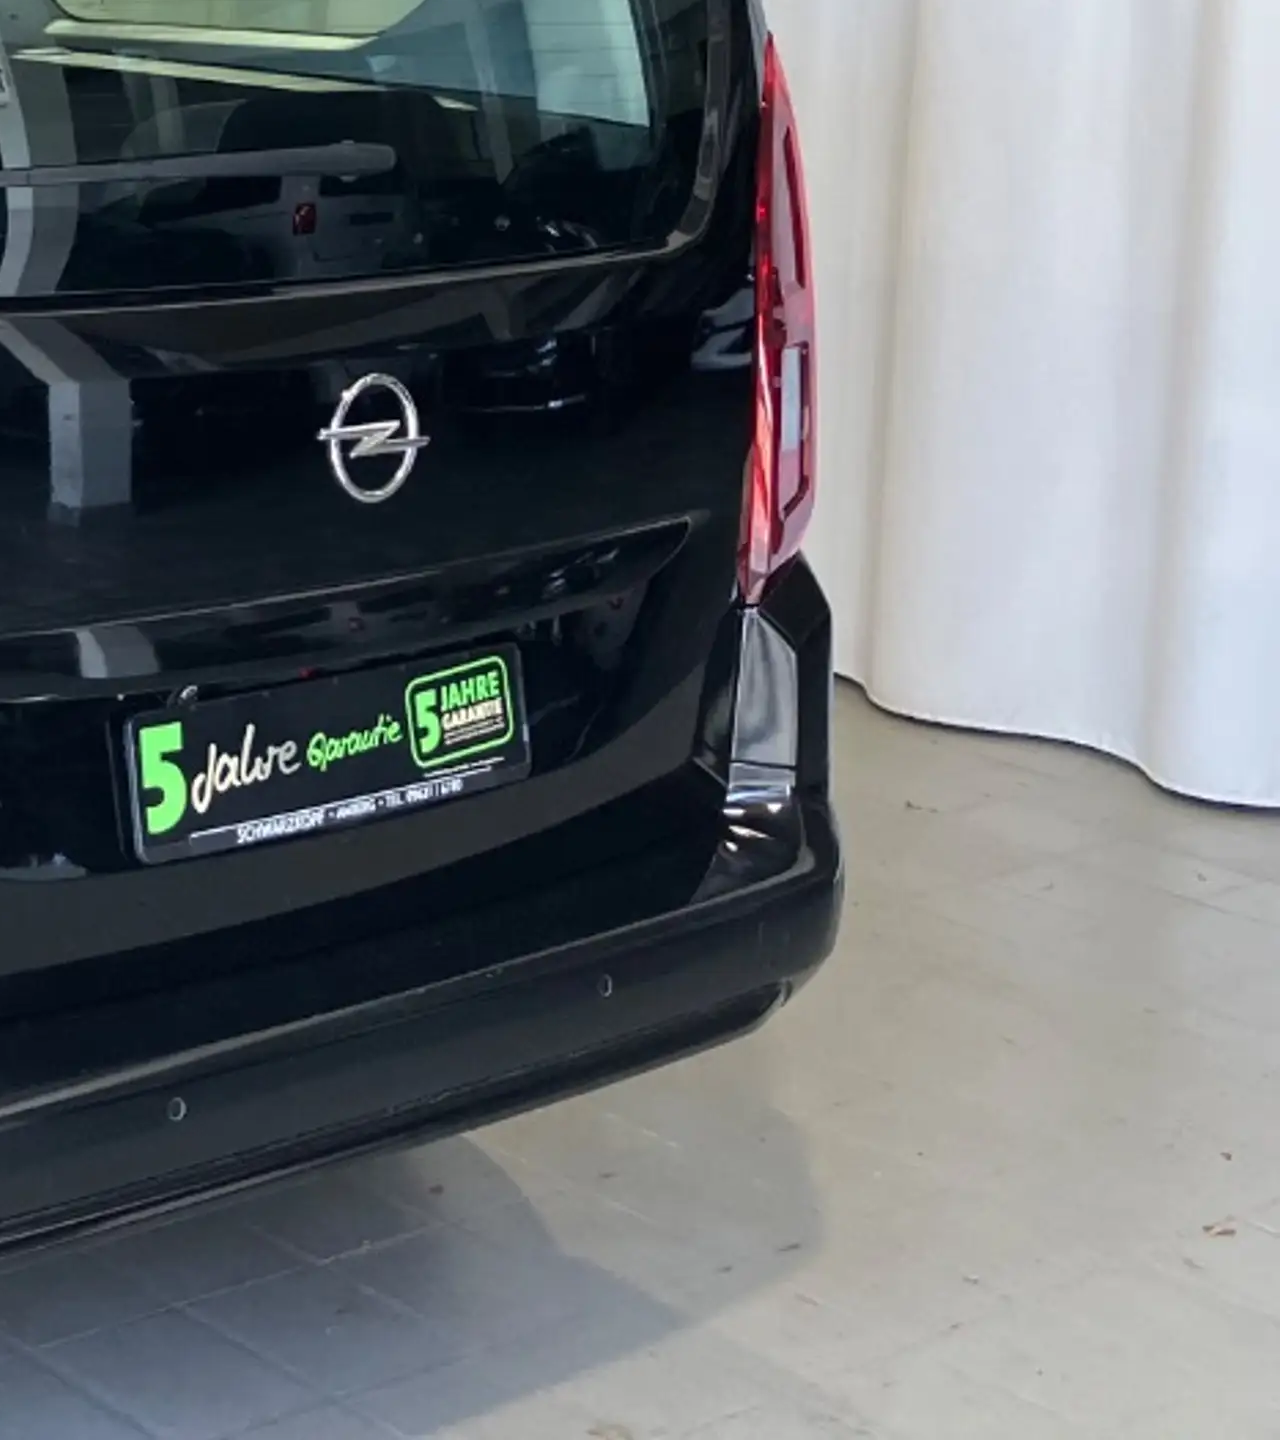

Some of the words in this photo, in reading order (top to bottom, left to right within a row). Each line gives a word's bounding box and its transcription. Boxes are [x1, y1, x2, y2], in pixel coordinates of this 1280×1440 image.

[415, 687, 441, 754] 5
[441, 669, 500, 712] JAHRE
[139, 721, 188, 835] 5
